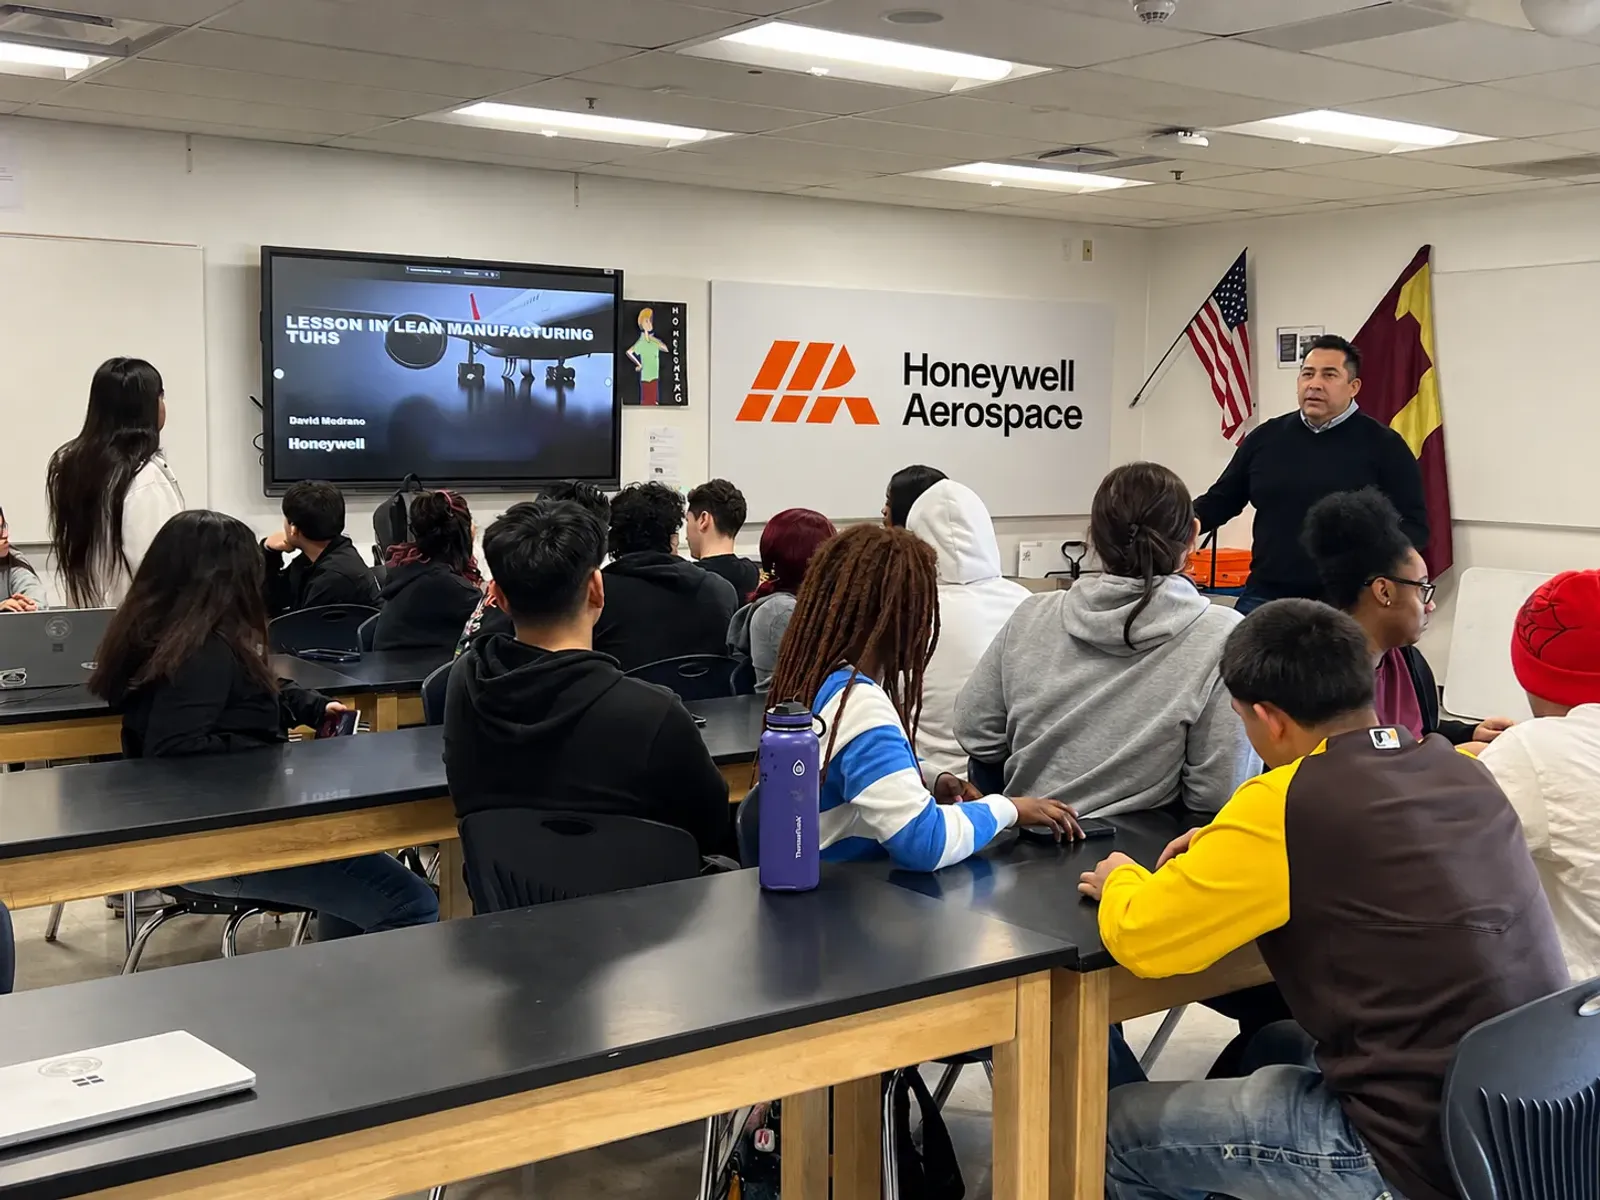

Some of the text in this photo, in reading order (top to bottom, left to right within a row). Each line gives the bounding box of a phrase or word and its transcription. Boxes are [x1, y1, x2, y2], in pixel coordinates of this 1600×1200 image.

[285, 330, 340, 345] TUHS
[286, 315, 594, 341] LESSON IN LEAN MANUFACTURING
[904, 352, 1075, 398] Honeywell
[289, 416, 366, 426] David Medrano
[902, 393, 1083, 437] Aerospace
[288, 437, 365, 452] Honeywell
